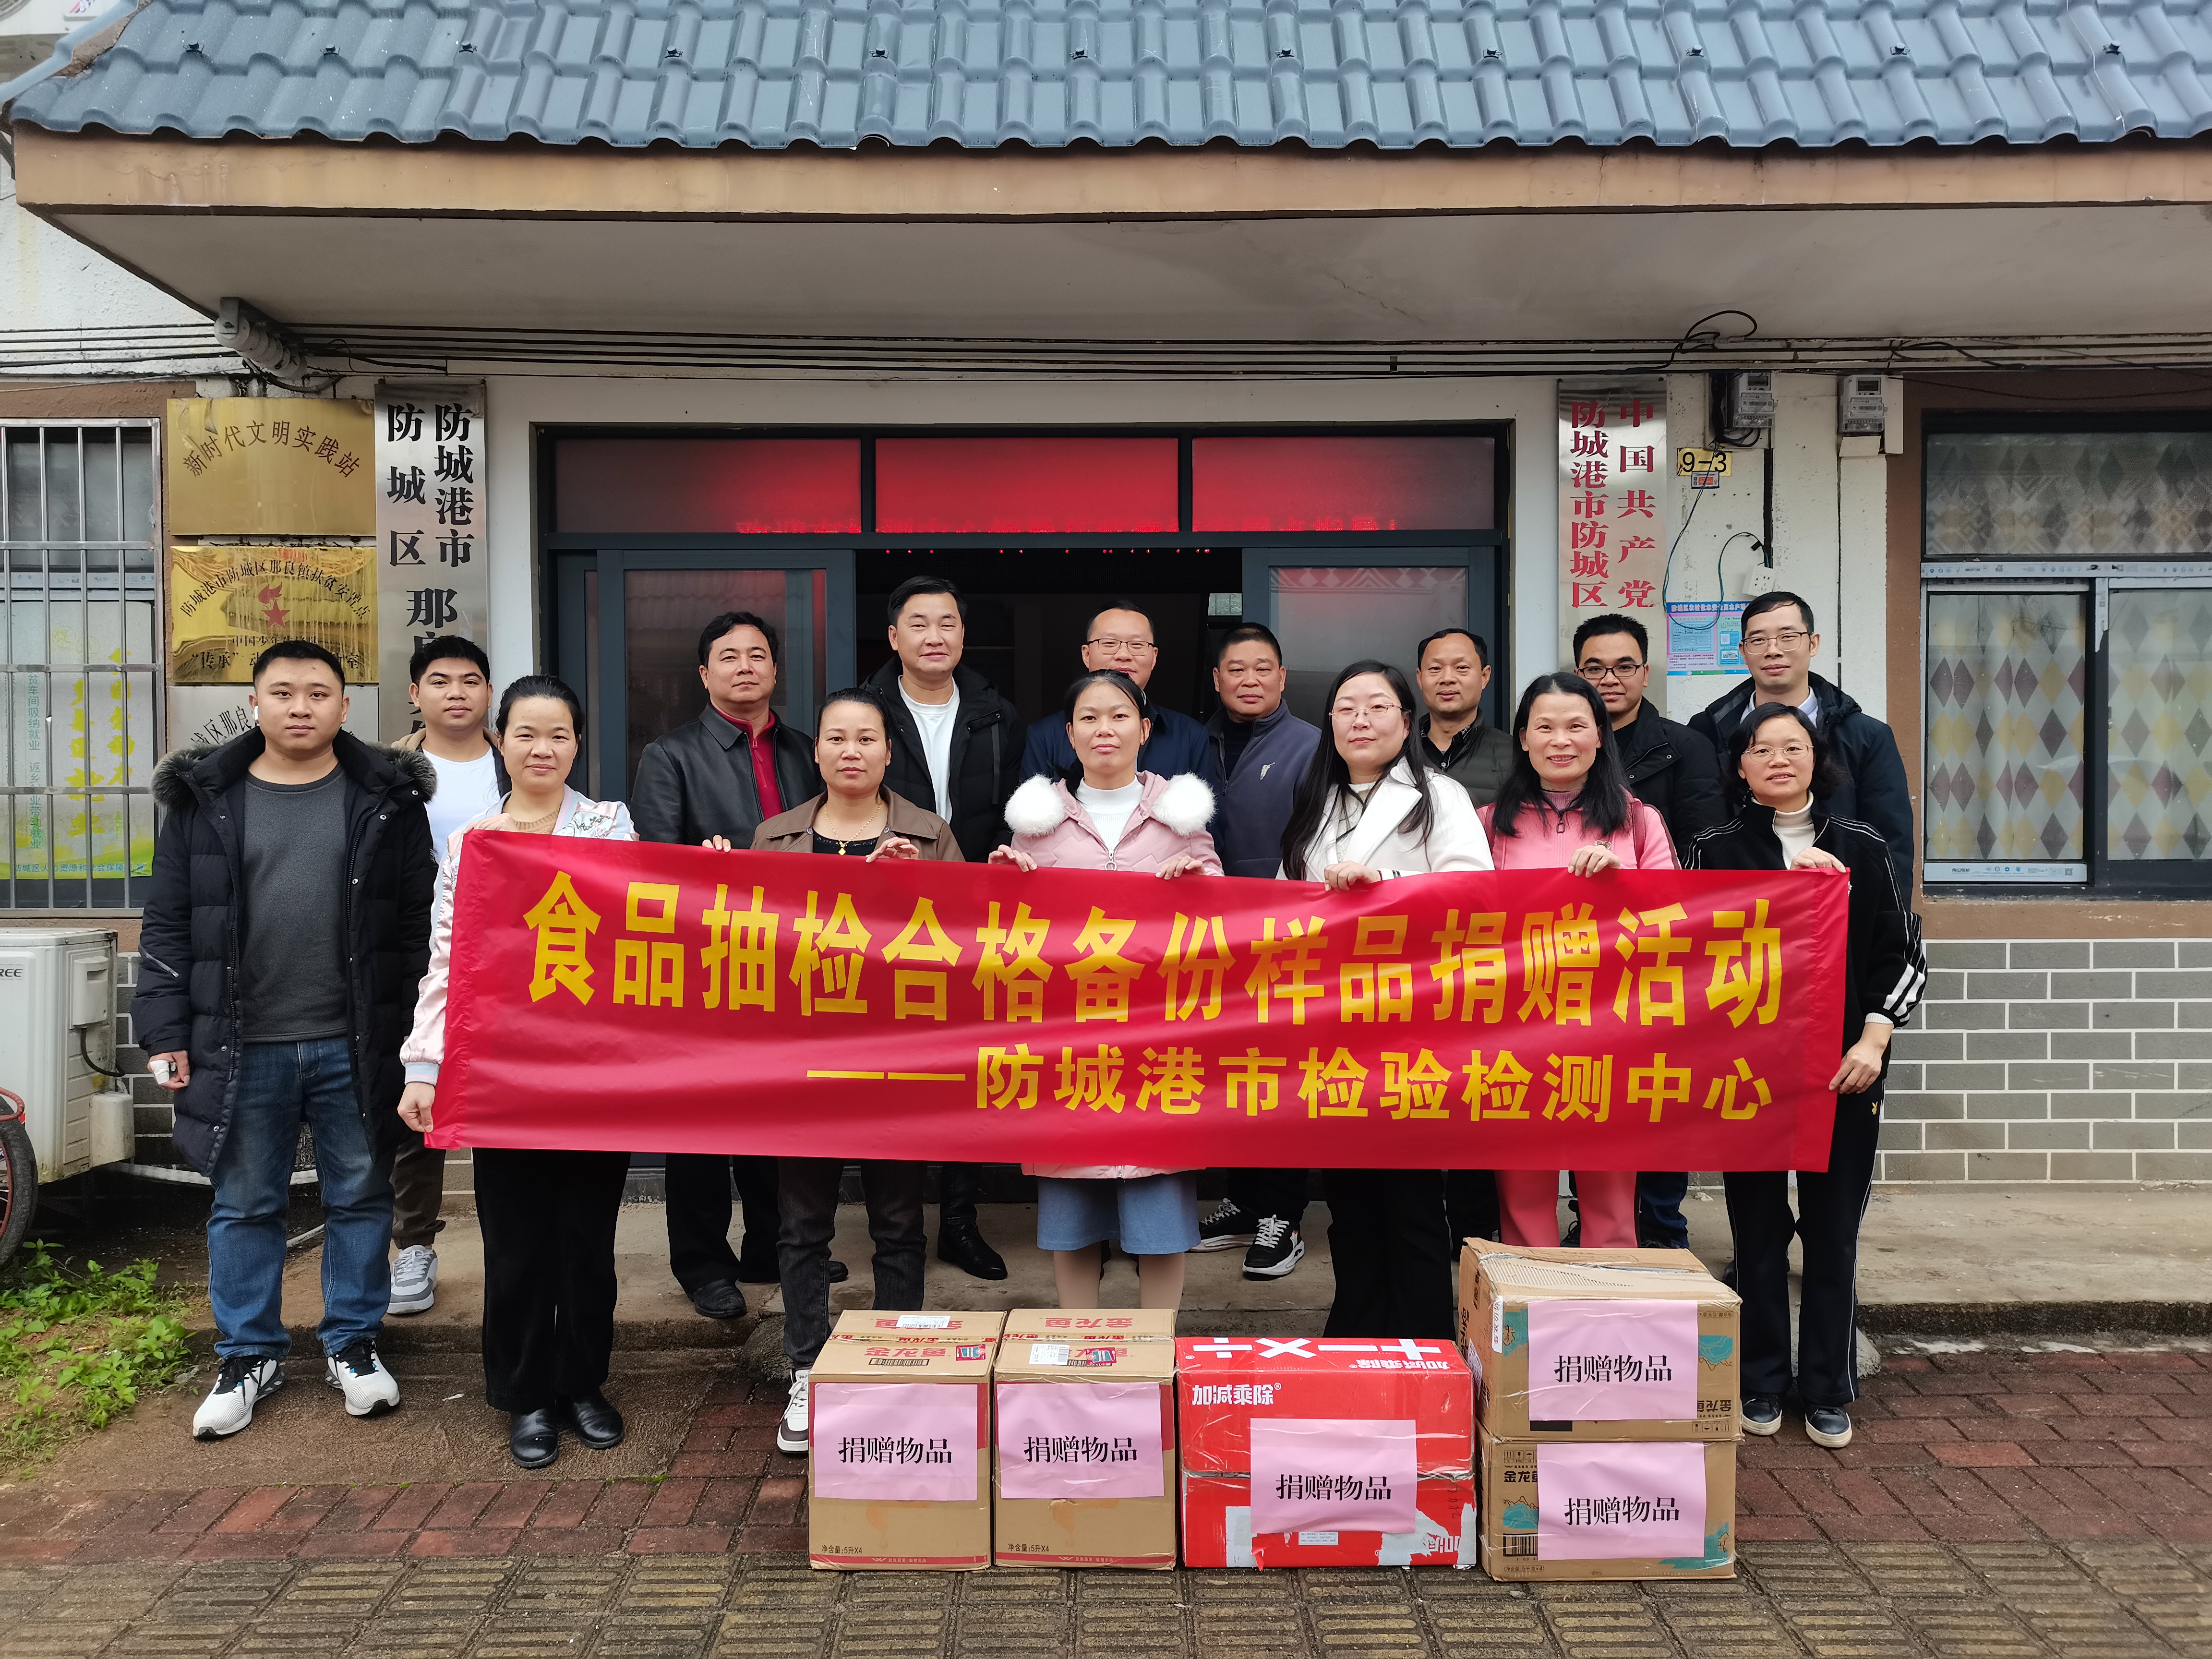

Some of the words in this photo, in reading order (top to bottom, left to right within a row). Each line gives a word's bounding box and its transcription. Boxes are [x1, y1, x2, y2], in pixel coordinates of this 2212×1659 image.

[183, 421, 360, 478] 新时代文明实践站
[386, 403, 426, 566] 防城区
[434, 403, 474, 567] 防城港市
[1570, 400, 1609, 608] 防城港市防城区
[1618, 400, 1656, 608] 中国共产党
[180, 560, 370, 620] 防城港市防城区那良镇扶贫安置点
[27, 671, 40, 750] 贫车间吸纳就业
[523, 870, 1783, 1028] 食品抽检合格备份样品捐赠活动
[1045, 1318, 1132, 1328] 金龙鱼
[865, 1347, 947, 1357] 金龙鱼
[1554, 1354, 1672, 1382] 捐赠物品
[838, 1436, 952, 1464] 捐赠物品
[1023, 1435, 1137, 1463] 捐赠物品
[1275, 1474, 1392, 1501] 捐赠物品
[1564, 1496, 1680, 1526] 捐赠物品
